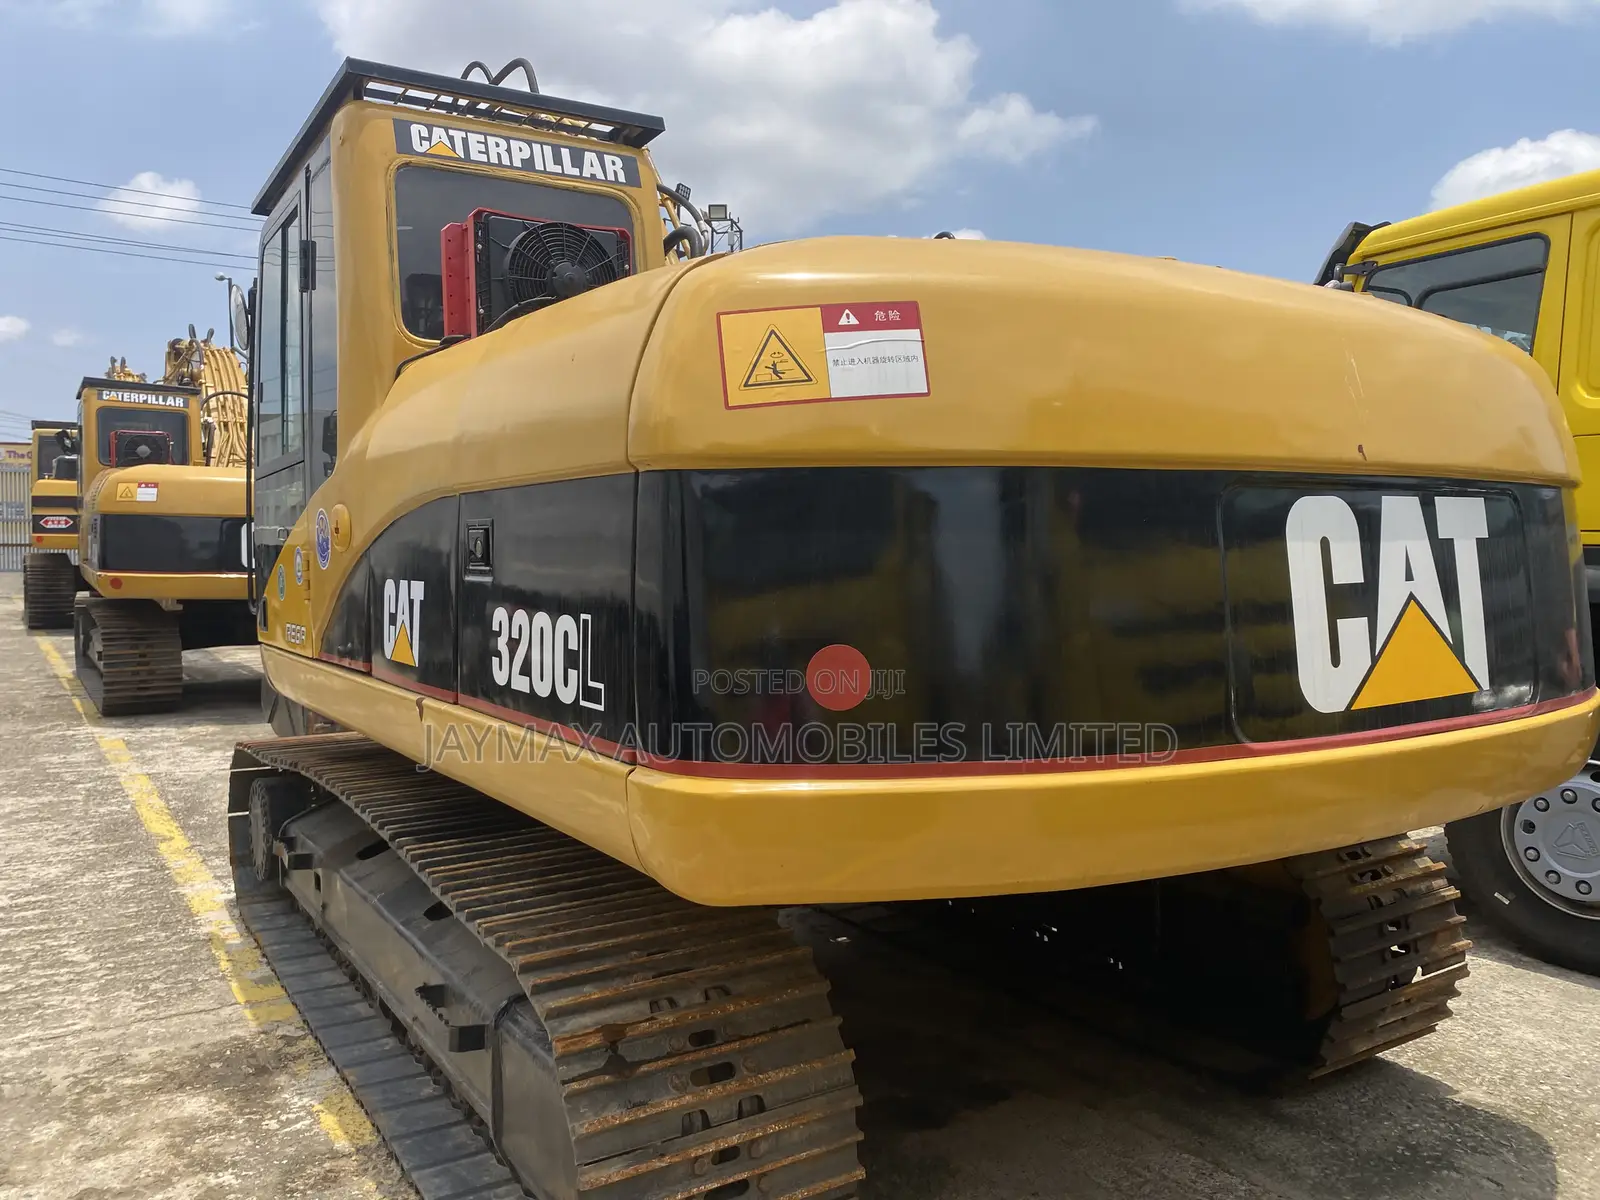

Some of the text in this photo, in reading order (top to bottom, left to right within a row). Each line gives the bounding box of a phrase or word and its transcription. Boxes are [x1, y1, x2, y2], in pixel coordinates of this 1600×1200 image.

[410, 123, 627, 183] CATERPILLAR
[874, 309, 901, 322] 危险
[832, 355, 919, 367] 禁止进入机器旋转区域内
[102, 390, 184, 407] CATERPILLAR
[383, 578, 425, 668] CAT
[1285, 495, 1490, 714] CAT
[491, 606, 605, 712] 320CL
